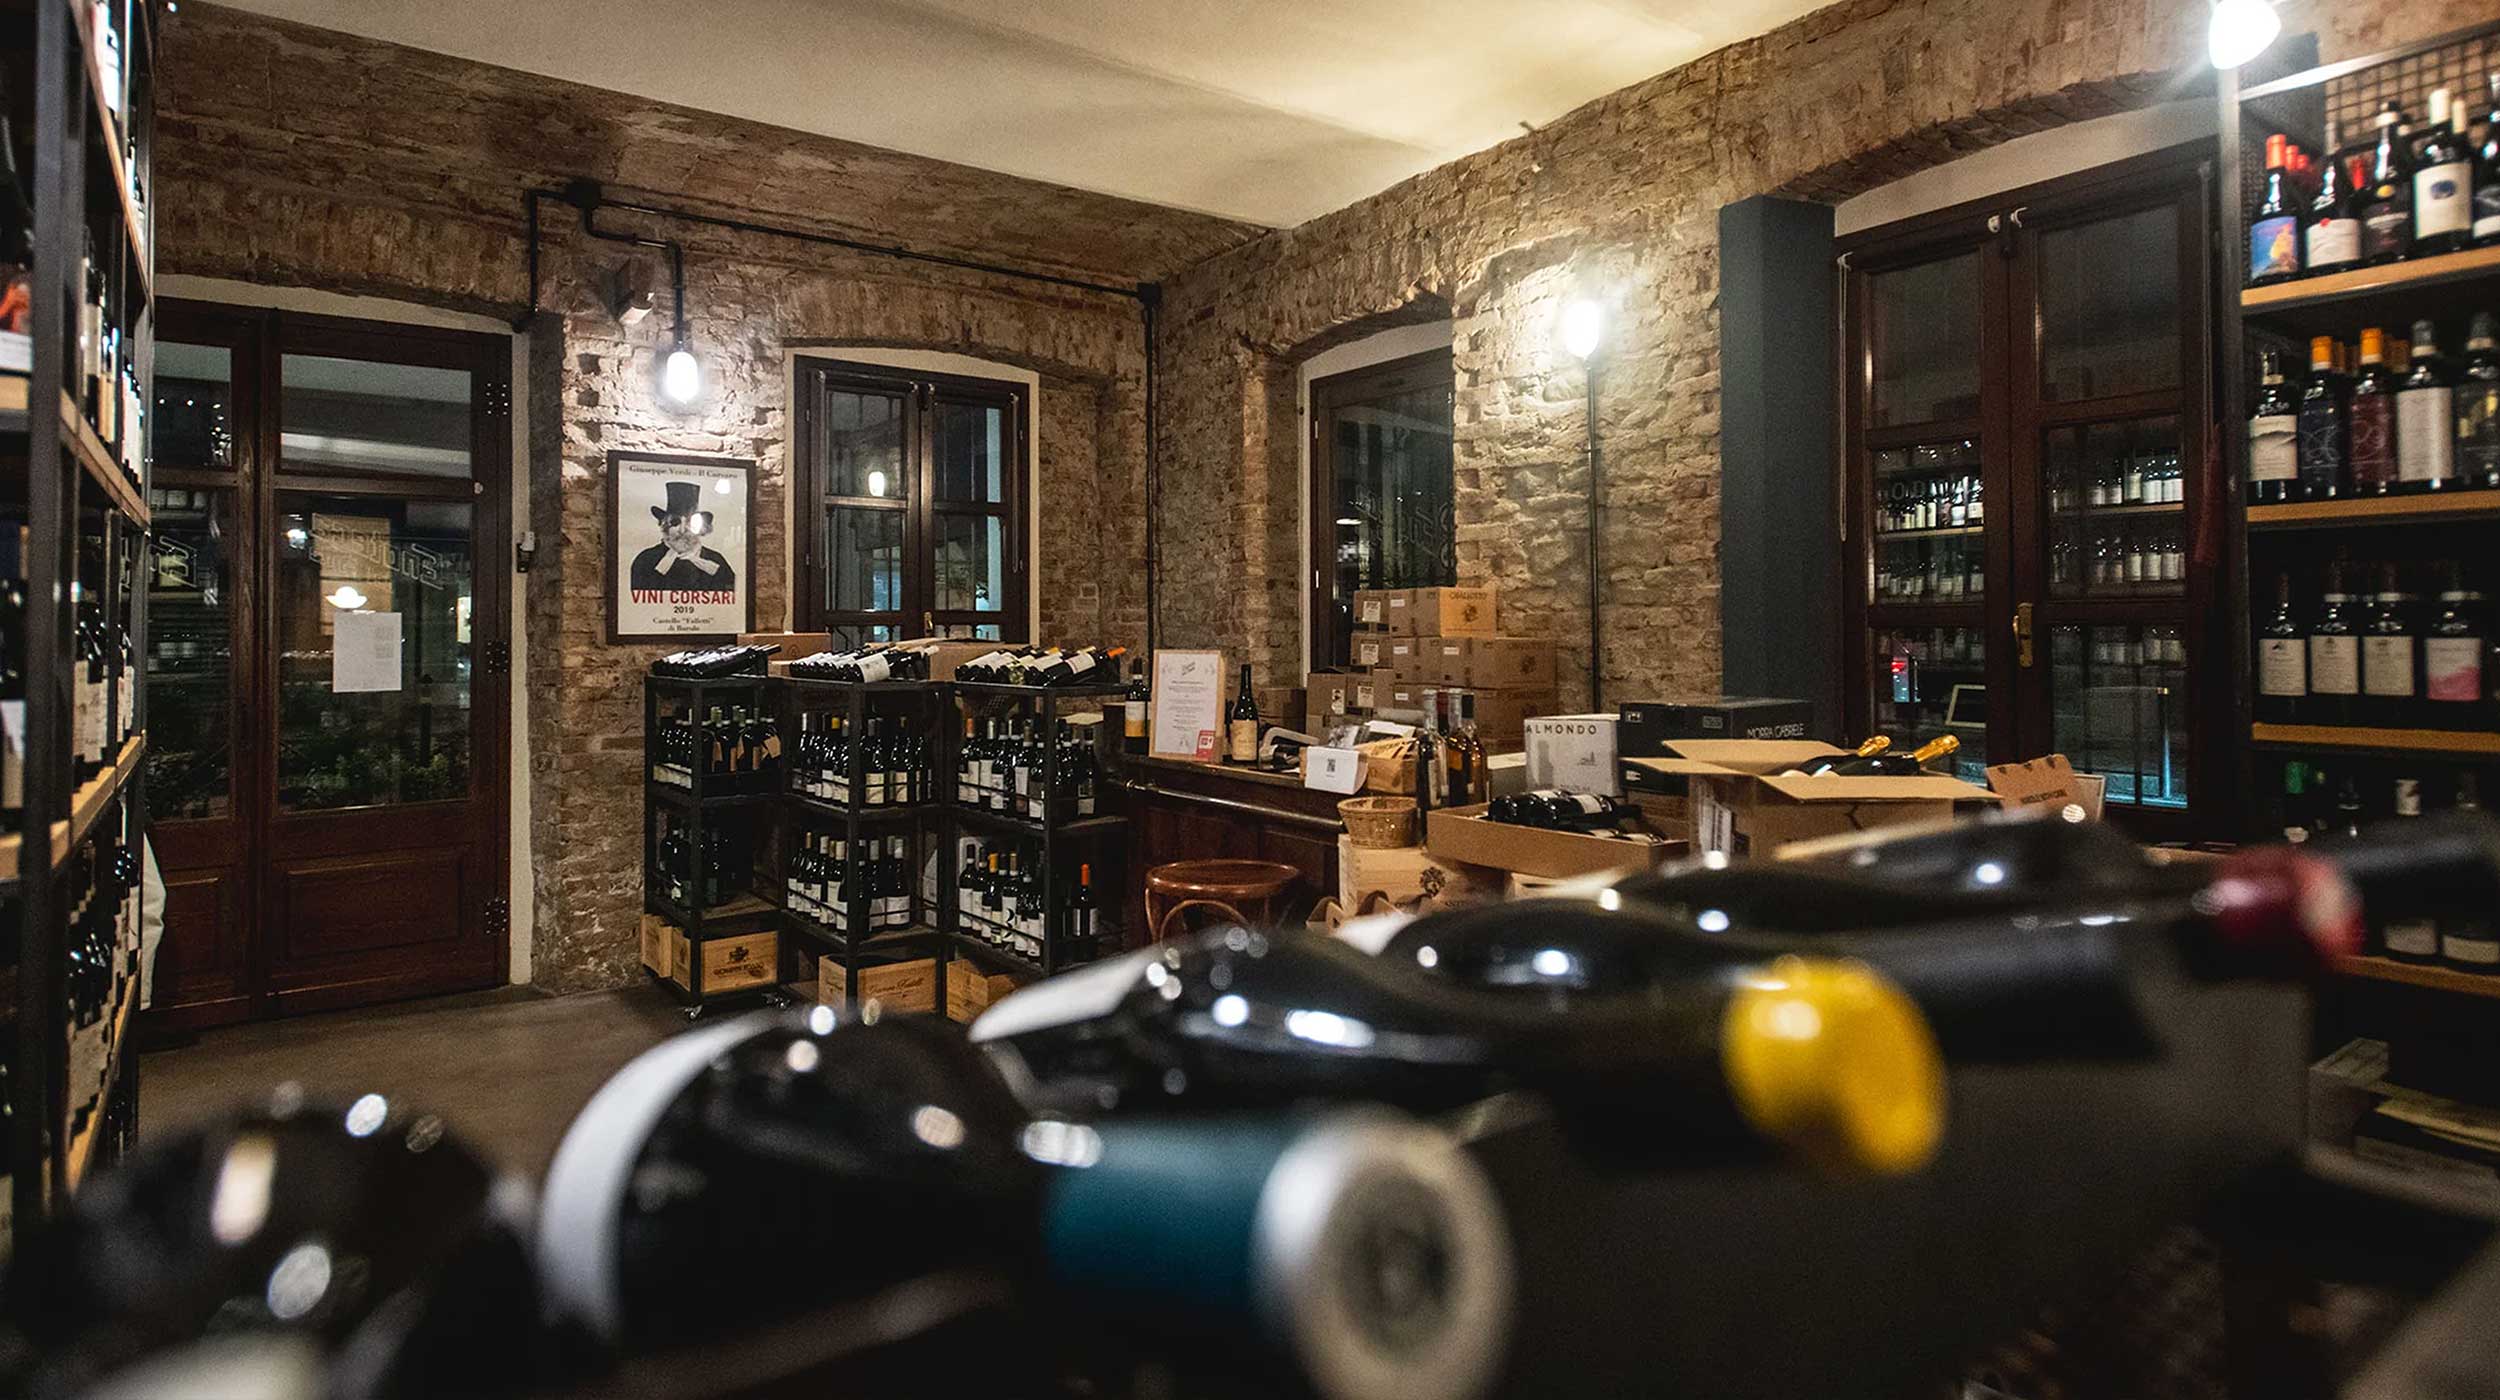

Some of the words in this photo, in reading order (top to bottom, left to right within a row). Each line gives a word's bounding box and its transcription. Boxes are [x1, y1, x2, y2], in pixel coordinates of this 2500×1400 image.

[631, 589, 664, 604] VINI
[669, 590, 736, 605] CORSARI
[673, 605, 695, 614] 2019
[1526, 724, 1597, 735] ALMONDO
